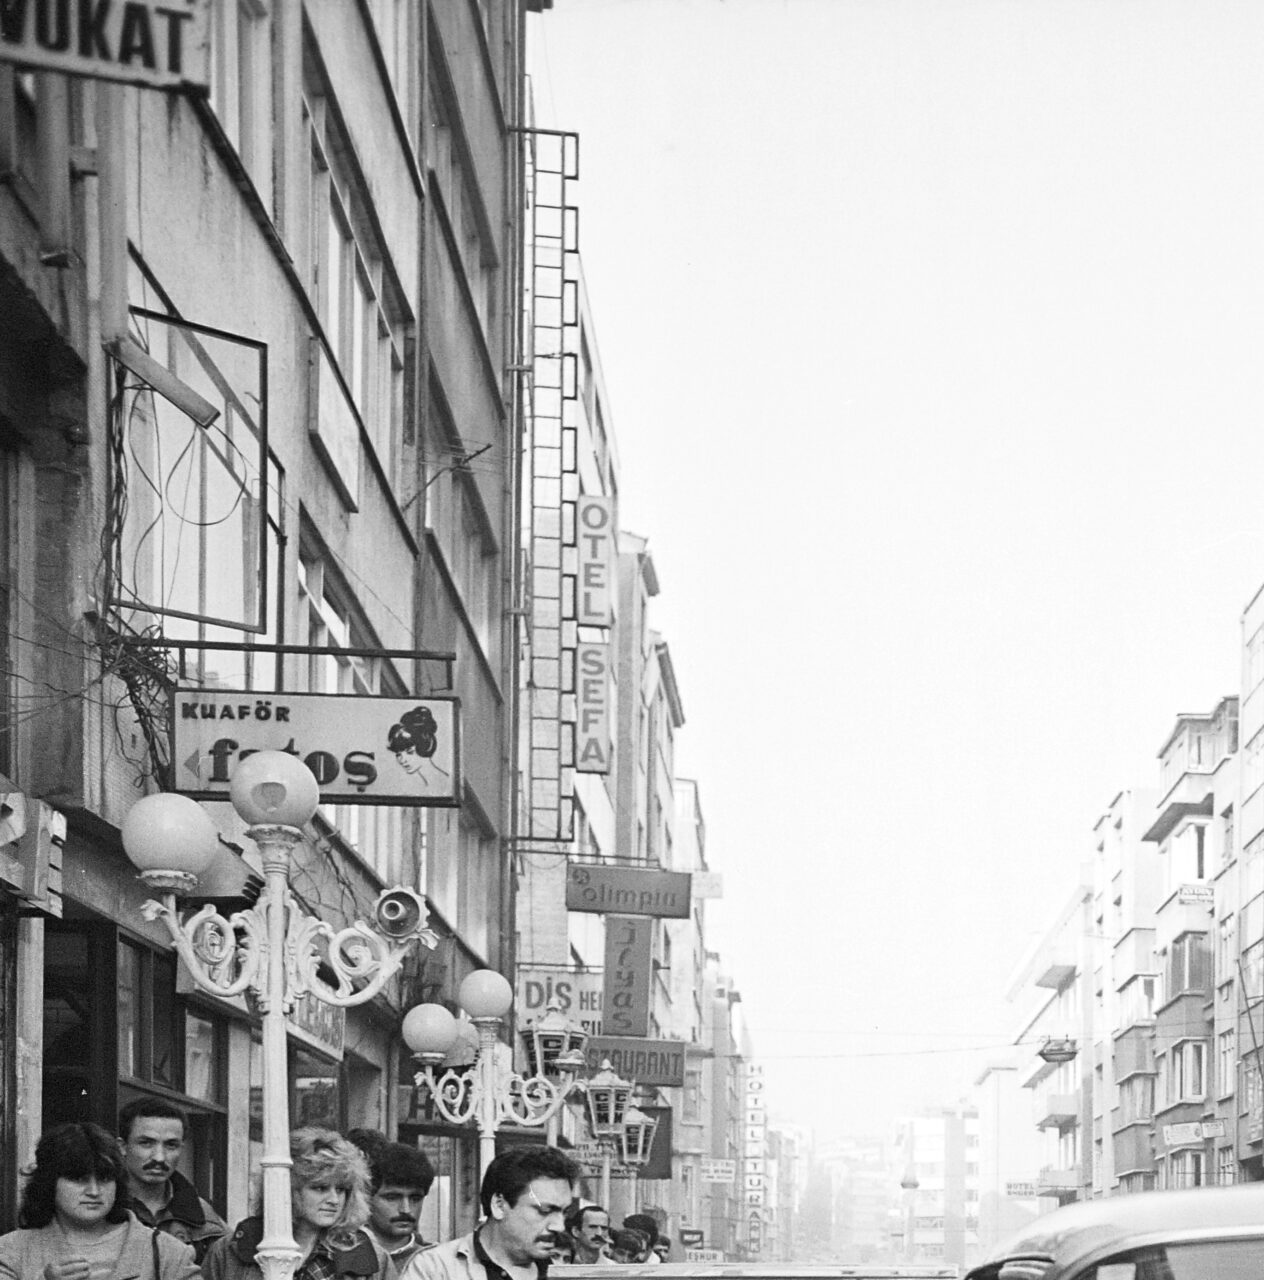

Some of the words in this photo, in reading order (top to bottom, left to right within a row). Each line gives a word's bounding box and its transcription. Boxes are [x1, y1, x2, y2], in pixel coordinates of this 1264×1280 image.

[581, 503, 608, 617] OTEL
[182, 700, 290, 722] KUAFÖR
[580, 649, 605, 764] SEFA
[208, 737, 378, 792] foş
[588, 1048, 681, 1078] STAURANT
